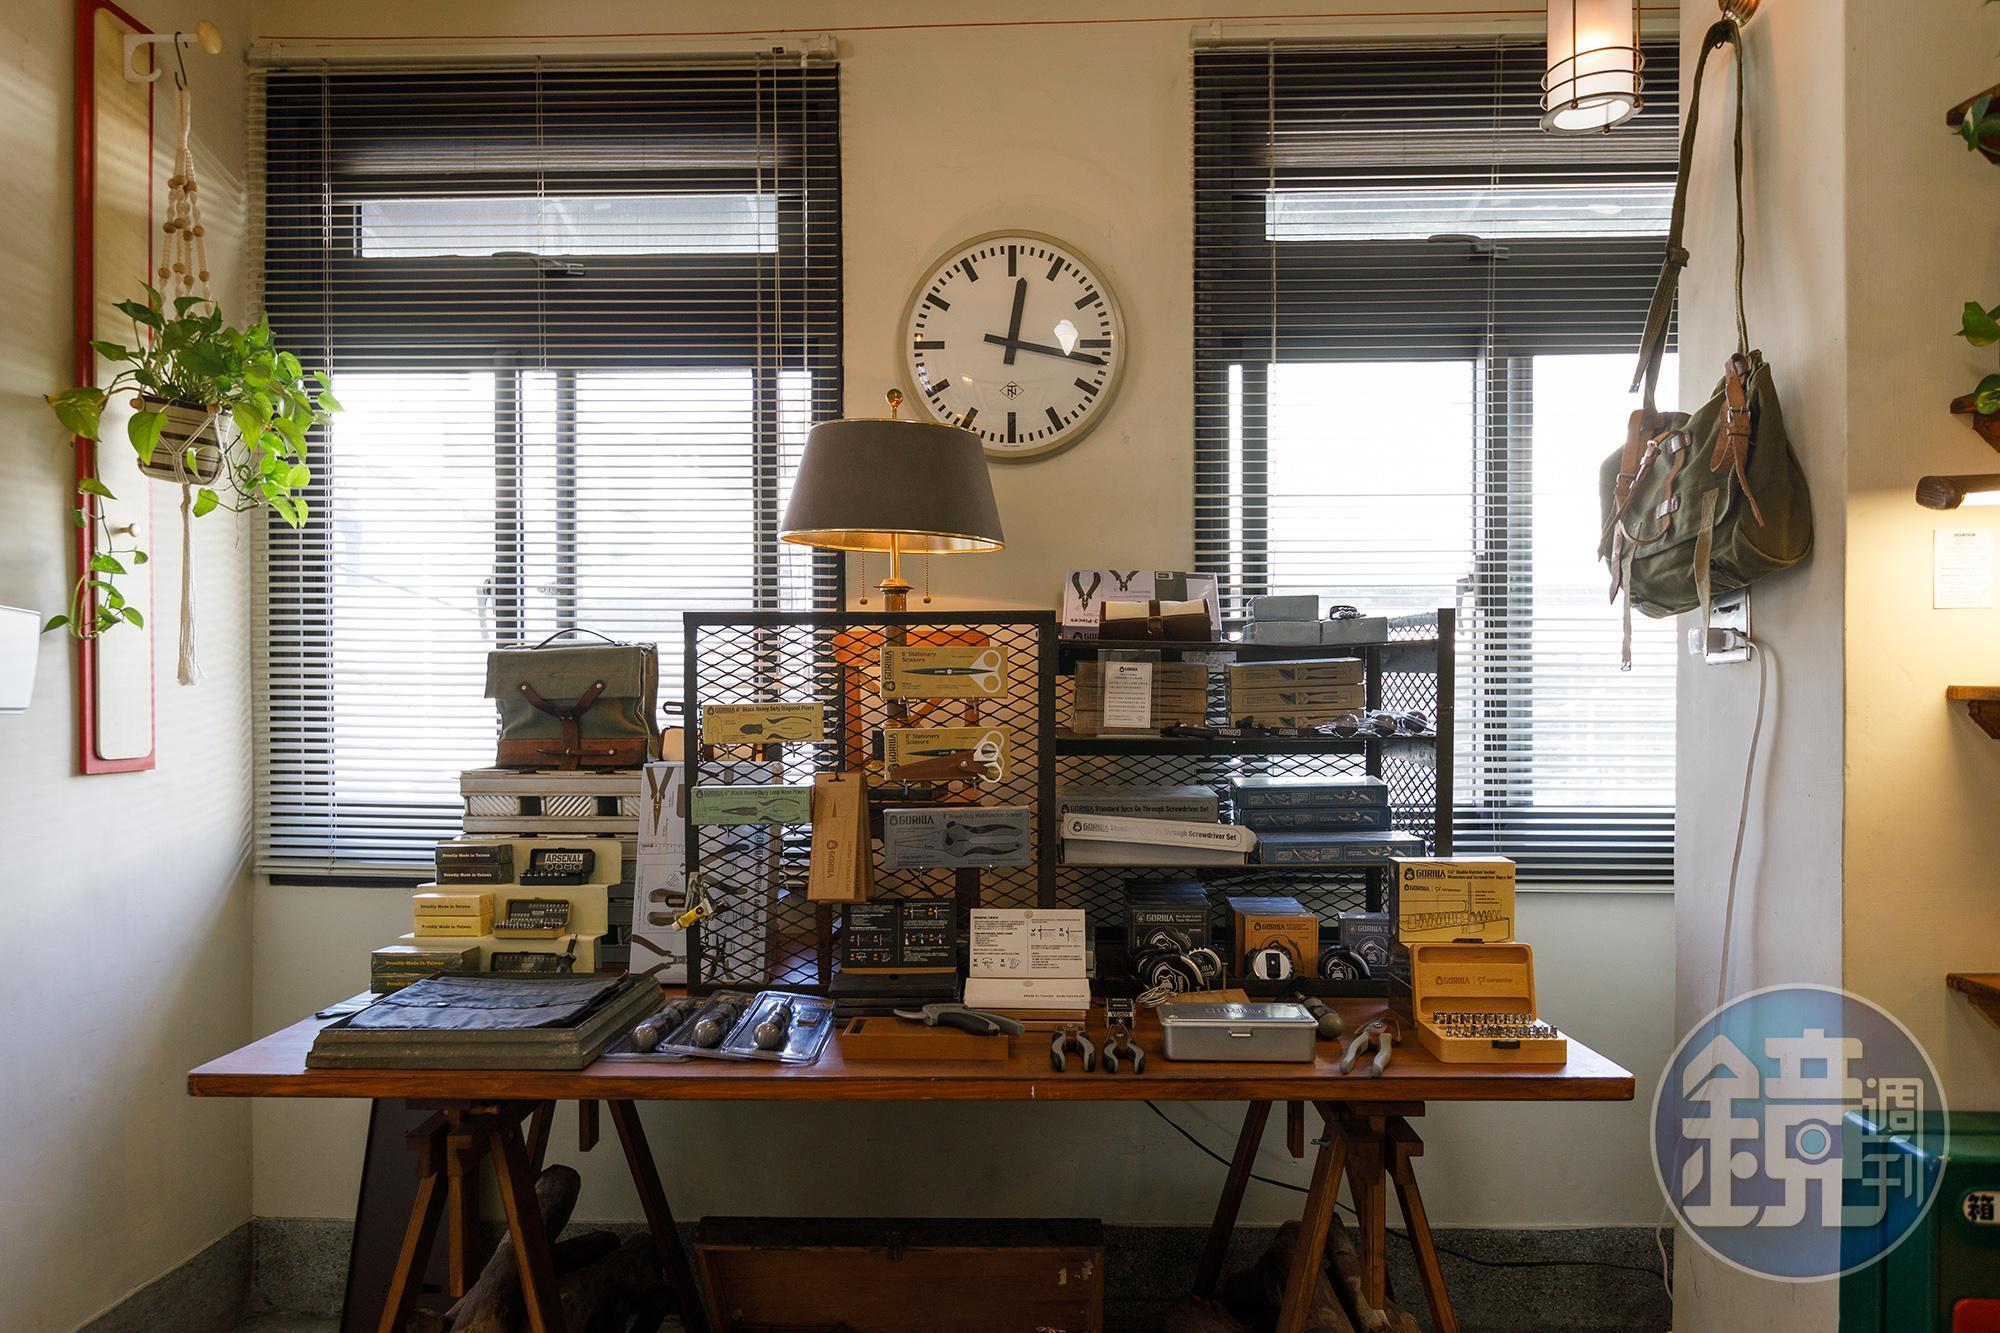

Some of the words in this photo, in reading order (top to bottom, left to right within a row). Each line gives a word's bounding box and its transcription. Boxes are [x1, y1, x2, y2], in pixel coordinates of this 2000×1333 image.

[909, 651, 937, 659] Stationery
[885, 650, 893, 680] GORILLA
[781, 705, 800, 713] Diagonal
[889, 733, 897, 762] GORILLA
[900, 815, 934, 825] GORILLA
[1188, 830, 1225, 840] Screwdriver
[1226, 833, 1237, 841] Set
[546, 854, 582, 863] ARSENAL
[827, 850, 837, 879] GORILLA
[1416, 869, 1446, 878] GORILLA
[1146, 914, 1175, 922] GORILLA
[1261, 923, 1286, 931] GORILLA
[1357, 925, 1383, 933] GORILLA
[1443, 976, 1470, 984] GORILLA
[1967, 1193, 1994, 1220] 箱
